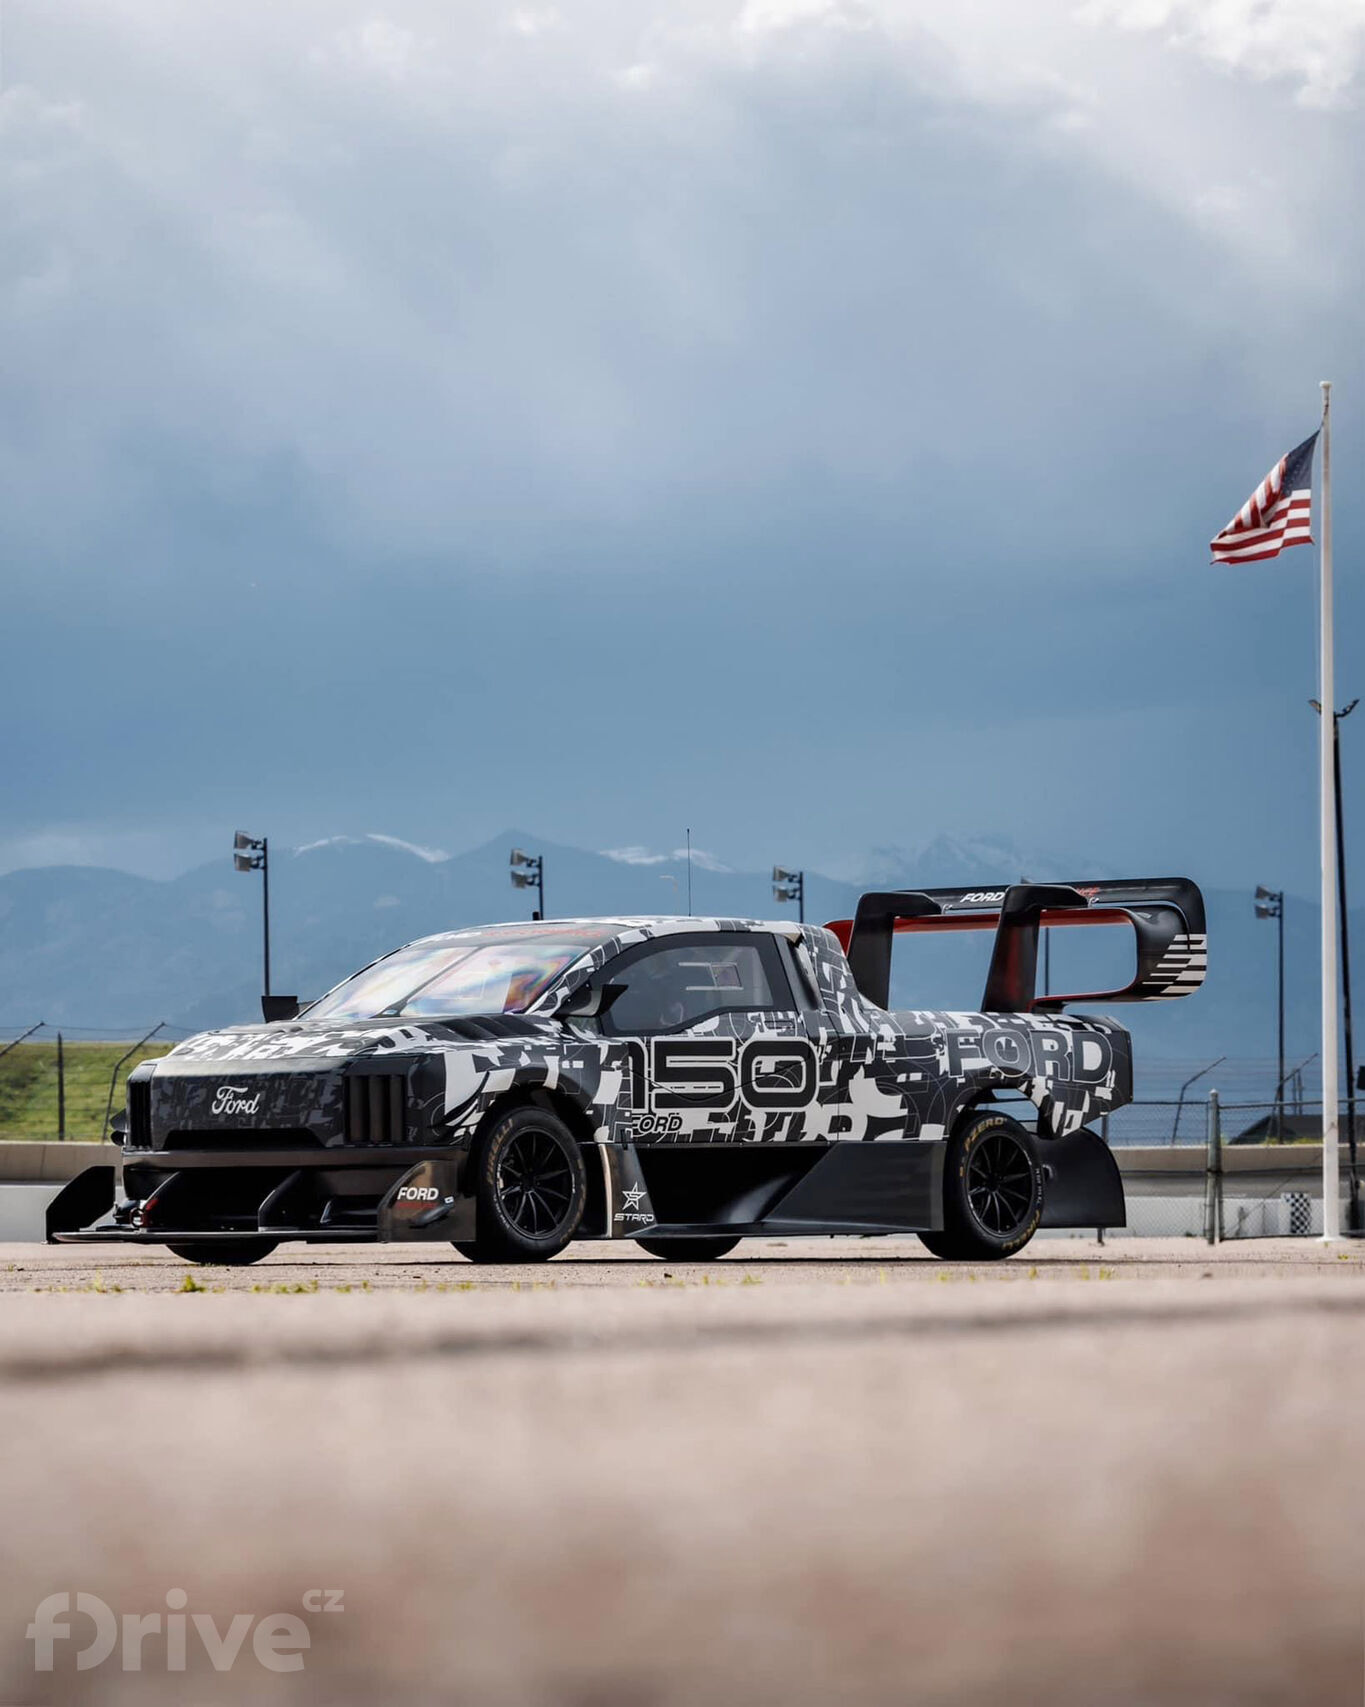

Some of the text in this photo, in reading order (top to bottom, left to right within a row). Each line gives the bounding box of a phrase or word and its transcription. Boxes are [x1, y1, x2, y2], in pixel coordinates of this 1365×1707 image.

[960, 891, 1005, 903] FORD
[945, 1028, 1113, 1084] FORD
[625, 1036, 819, 1113] 150
[211, 1085, 260, 1115] Ford
[396, 1186, 439, 1201] FORD
[613, 1212, 655, 1225] STARD
